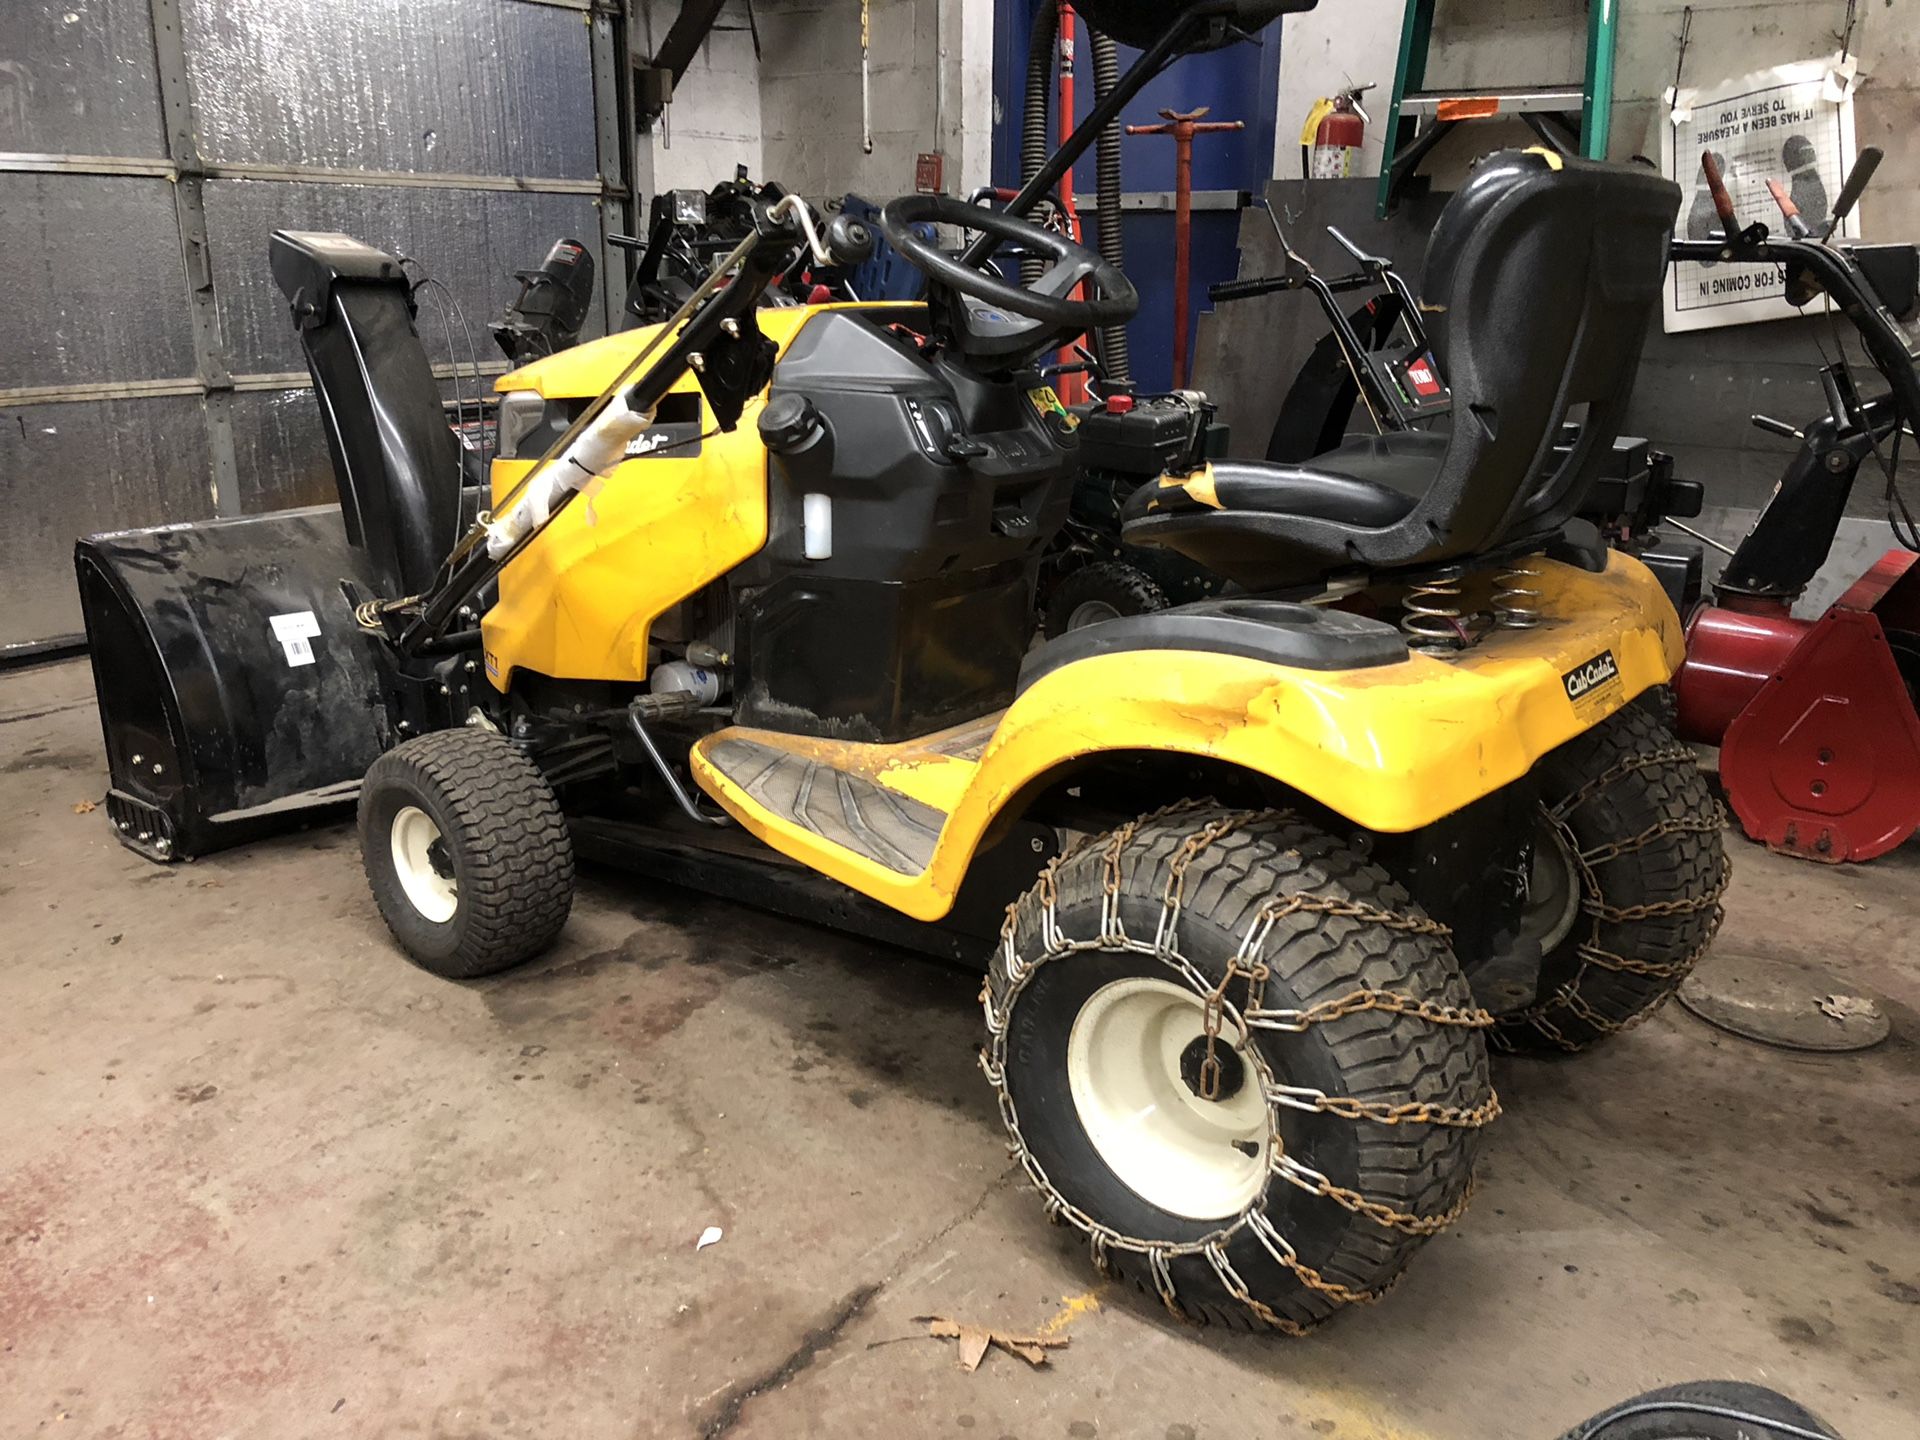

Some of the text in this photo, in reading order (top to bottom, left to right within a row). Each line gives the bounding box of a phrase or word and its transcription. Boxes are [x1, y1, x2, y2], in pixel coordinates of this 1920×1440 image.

[1720, 99, 1786, 124] TO SERVE YOU
[1697, 108, 1814, 144] IT HAS BEEN A PLEASURE
[1699, 281, 1709, 296] IN
[1712, 275, 1751, 294] COMING
[1754, 271, 1774, 288] FOR
[625, 433, 669, 454] det
[1567, 669, 1588, 696] Cub
[1586, 656, 1615, 685] Cadet
